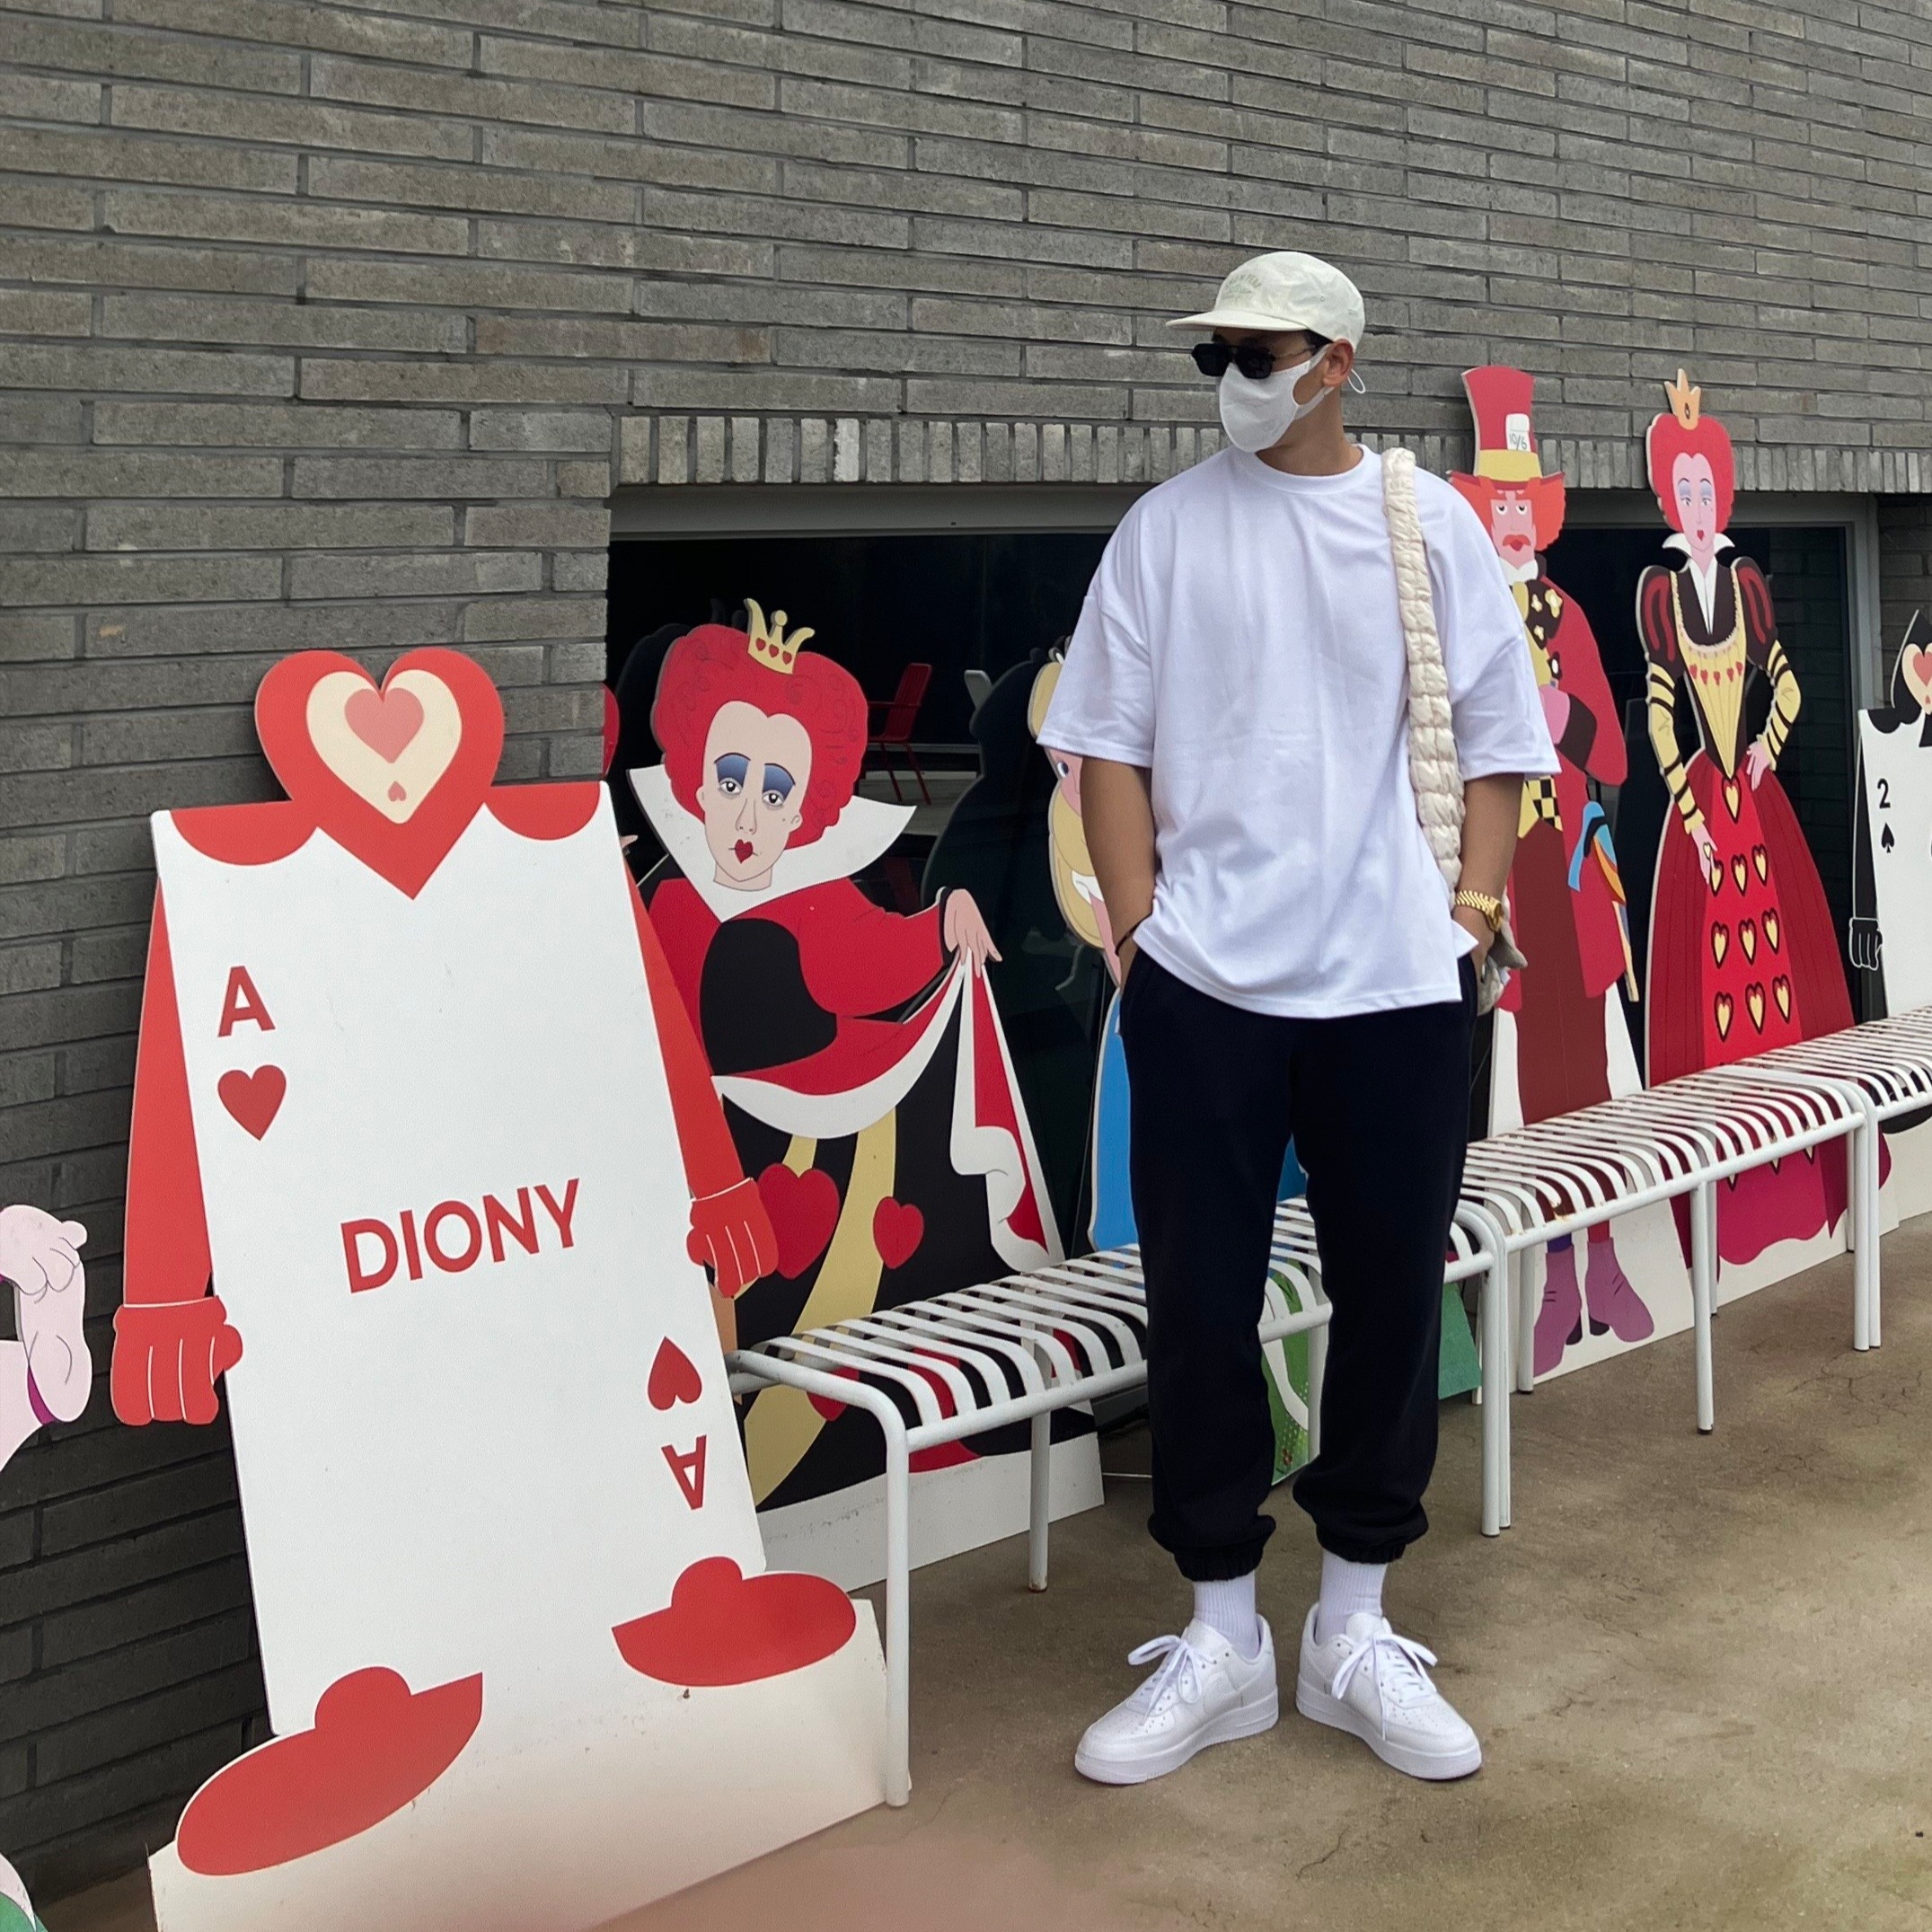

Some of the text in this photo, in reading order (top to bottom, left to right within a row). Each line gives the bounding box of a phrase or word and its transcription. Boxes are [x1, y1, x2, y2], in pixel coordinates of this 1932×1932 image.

[1509, 433, 1528, 451] 10/6
[1877, 778, 1891, 808] 2
[218, 966, 275, 1037] A
[340, 1178, 578, 1293] DIONY
[662, 1435, 707, 1510] A
